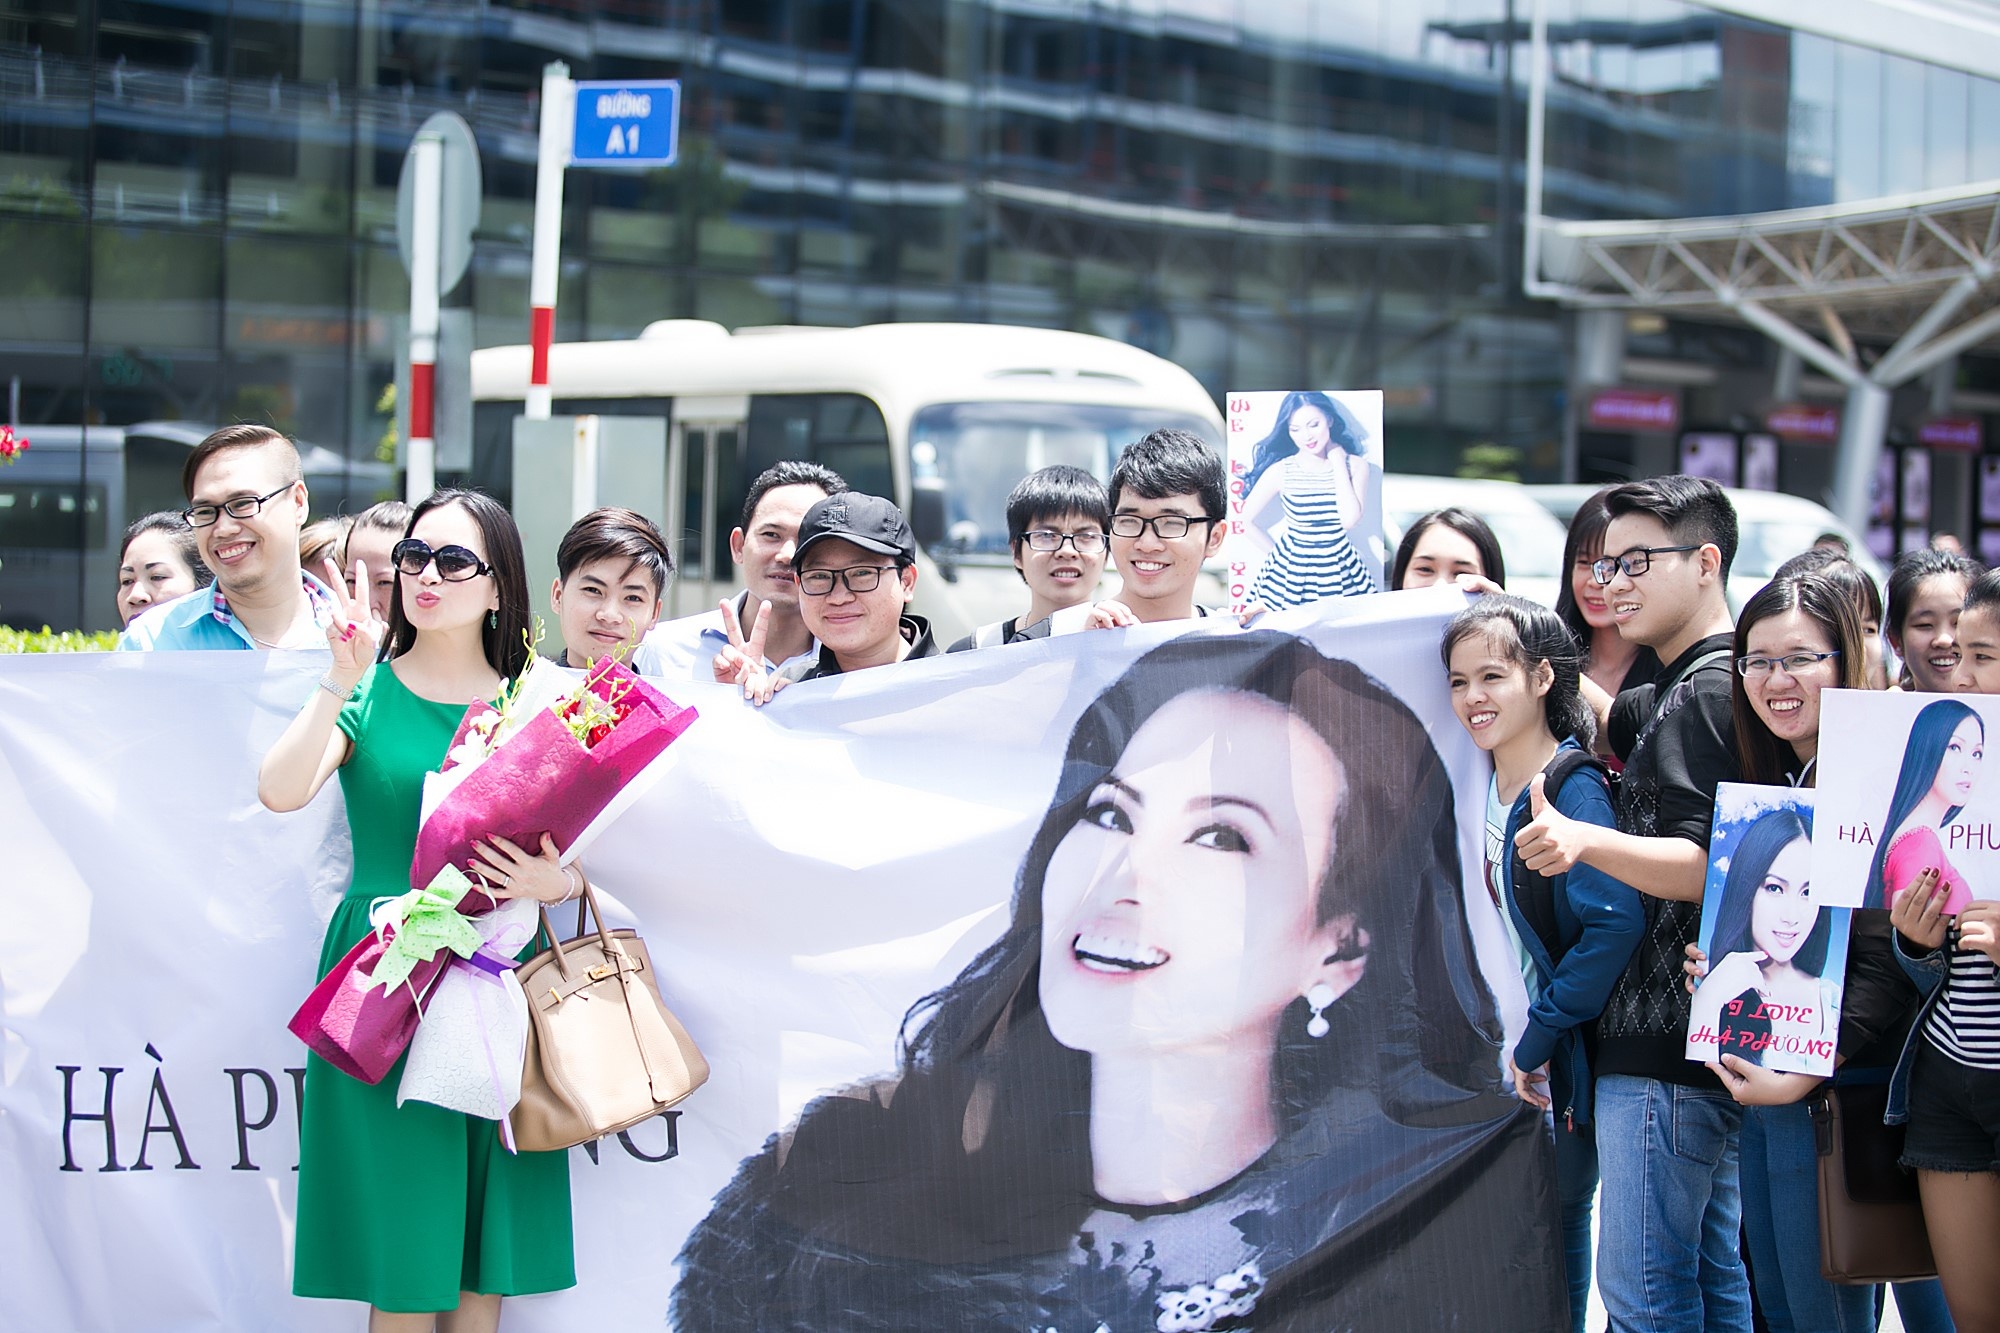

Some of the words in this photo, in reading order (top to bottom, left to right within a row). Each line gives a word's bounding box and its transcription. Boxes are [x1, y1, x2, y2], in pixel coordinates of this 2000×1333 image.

[605, 124, 640, 155] A1
[1230, 399, 1250, 432] WE
[1230, 459, 1247, 535] LOVE
[1838, 822, 1874, 846] HÀ
[1728, 1000, 1744, 1016] I
[1748, 1003, 1813, 1024] LOVE
[1689, 1025, 1735, 1046] HÀ
[1739, 1031, 1834, 1059] PHƯƠNG
[55, 1042, 201, 1172] HÀ
